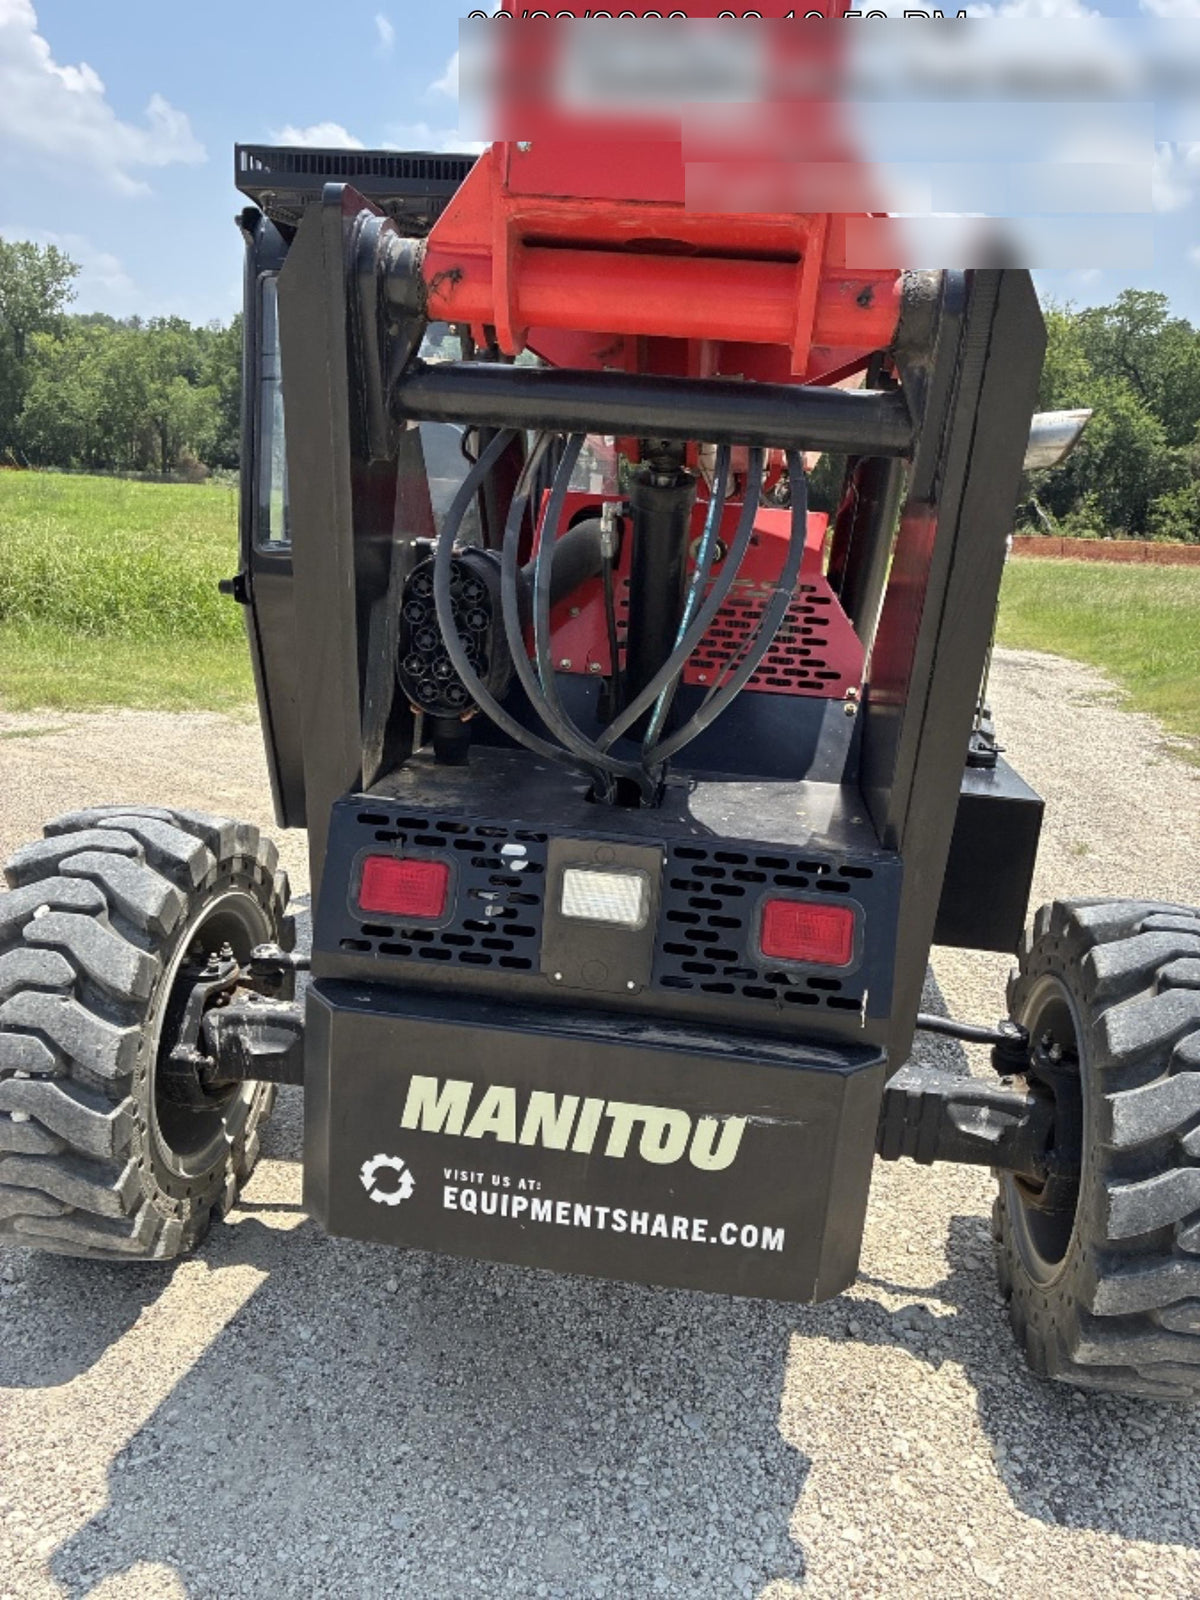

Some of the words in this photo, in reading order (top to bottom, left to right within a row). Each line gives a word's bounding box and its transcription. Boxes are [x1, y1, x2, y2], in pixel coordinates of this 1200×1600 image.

[400, 1074, 748, 1171] MANITOU
[443, 1167, 485, 1184] VISIT
[491, 1174, 511, 1188] US
[518, 1178, 541, 1191] AT:
[443, 1185, 785, 1252] EQUIPMENTSHARE.COM
